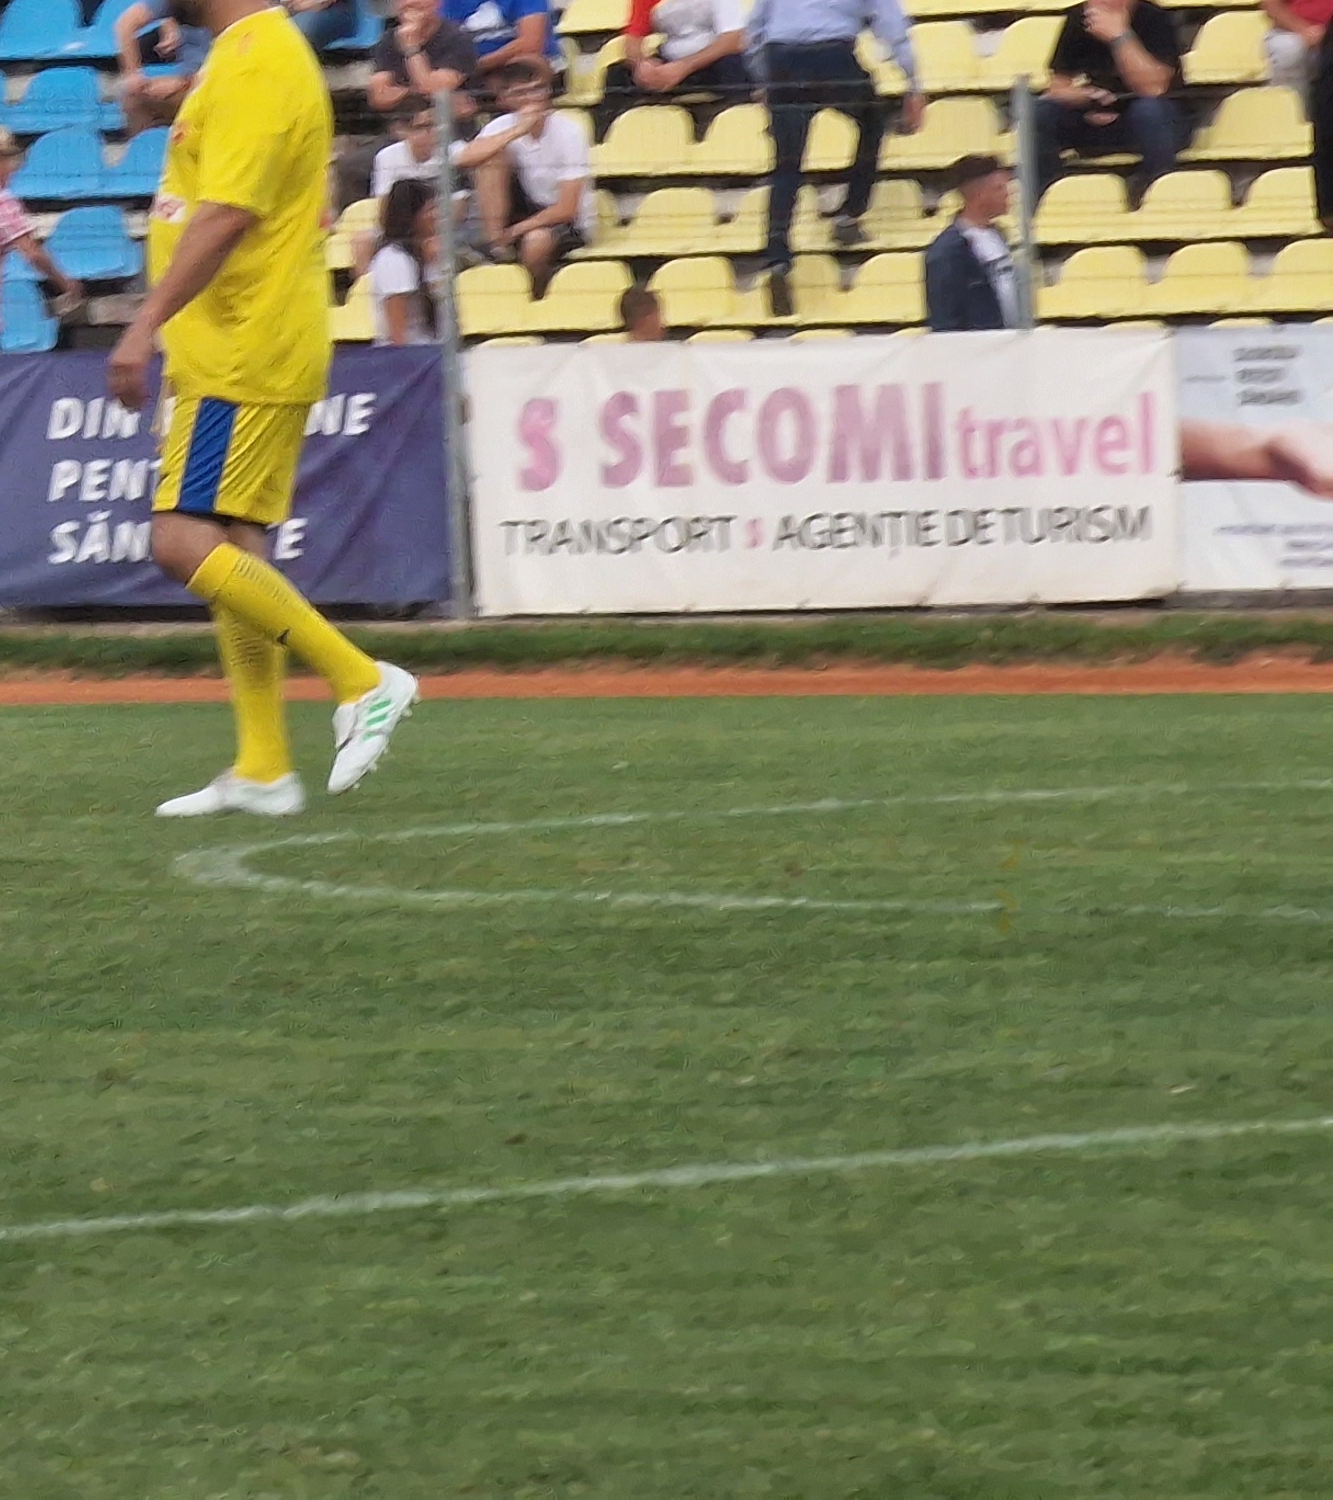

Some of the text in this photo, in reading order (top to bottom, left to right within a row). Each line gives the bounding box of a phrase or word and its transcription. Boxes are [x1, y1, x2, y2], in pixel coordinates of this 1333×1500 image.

[599, 382, 947, 489] SECOMI
[956, 390, 1156, 481] travel
[499, 514, 738, 556] TRANSPORT
